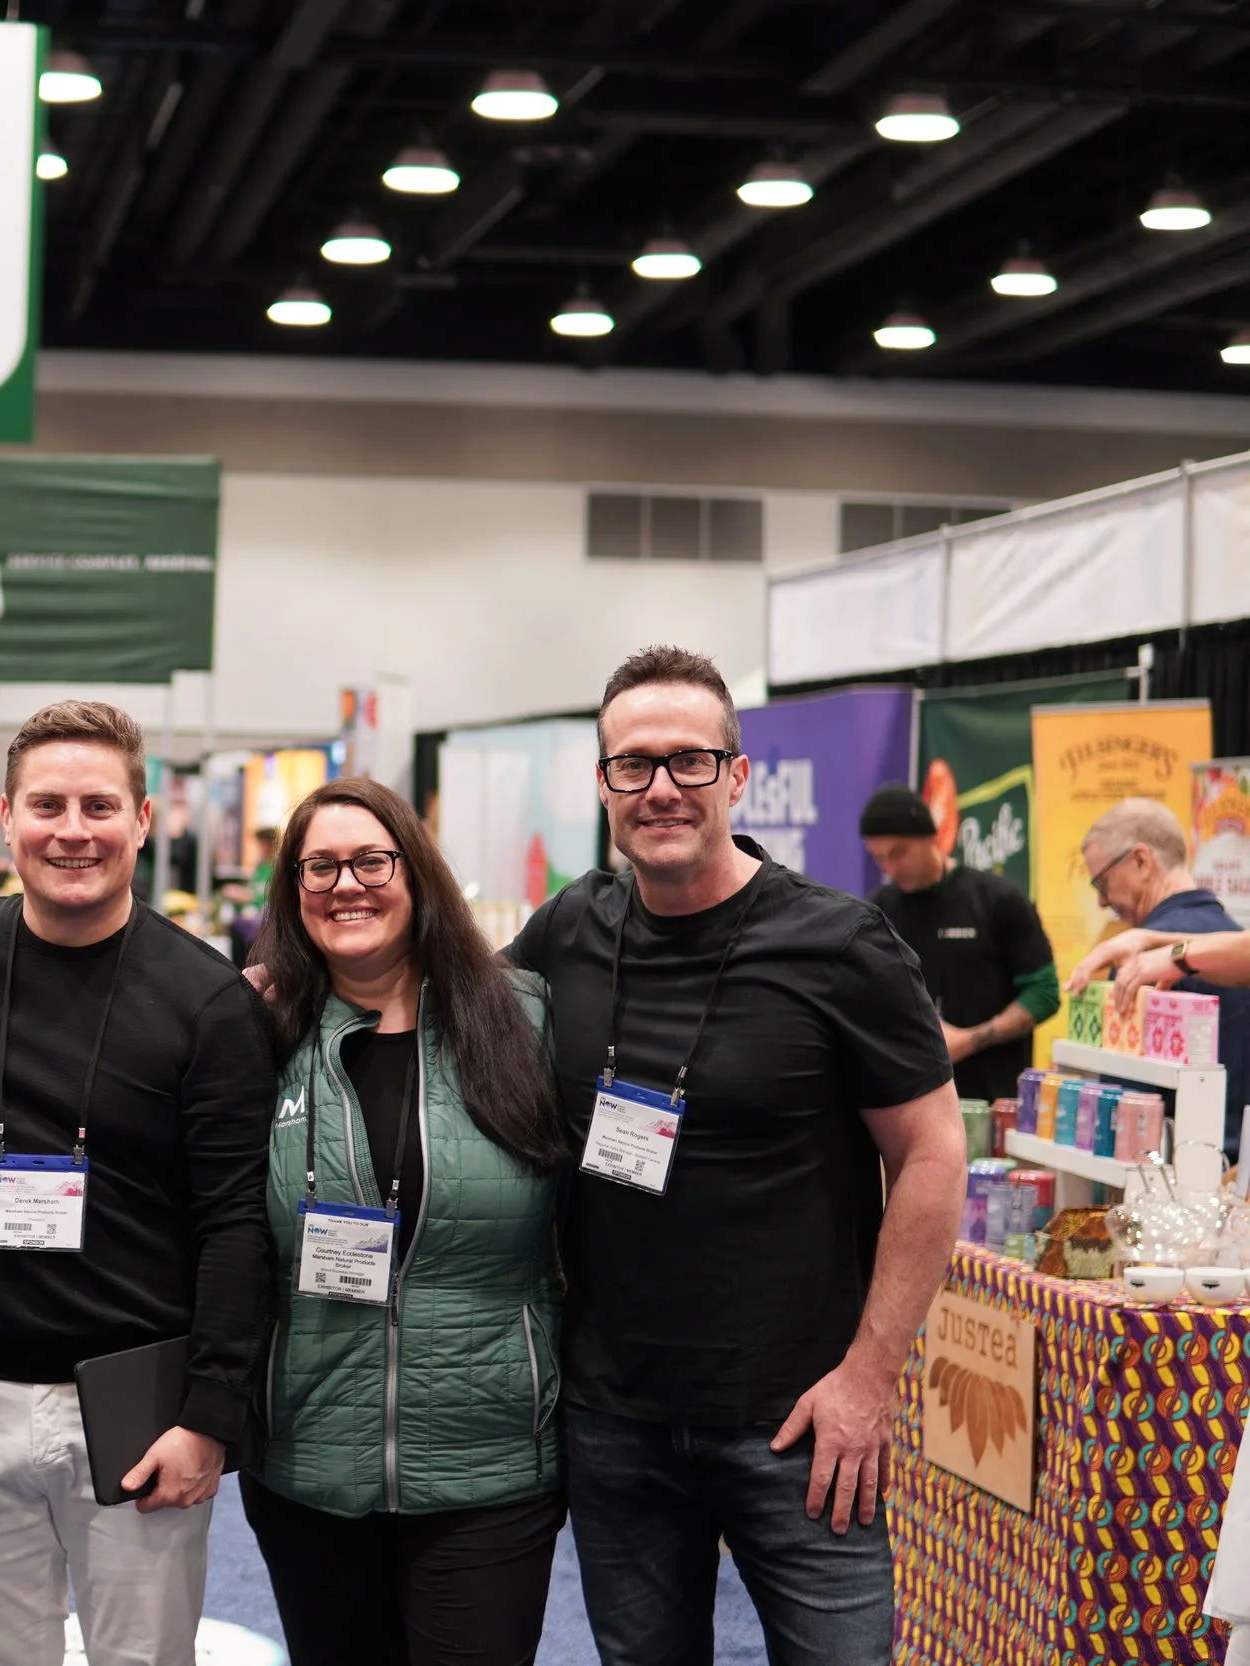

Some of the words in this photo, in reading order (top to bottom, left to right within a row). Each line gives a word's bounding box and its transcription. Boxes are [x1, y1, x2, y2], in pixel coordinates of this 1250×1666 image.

[958, 802, 1025, 871] Pacific
[278, 1085, 306, 1119] M
[616, 1126, 629, 1136] Sean
[630, 1129, 649, 1142] Rogers
[312, 1253, 335, 1261] Marsham
[335, 1255, 353, 1263] Natural
[354, 1258, 376, 1266] Products
[316, 1246, 342, 1257] Courtney
[342, 1249, 374, 1259] Ecclestone
[317, 1284, 342, 1292] EXHIBITOR
